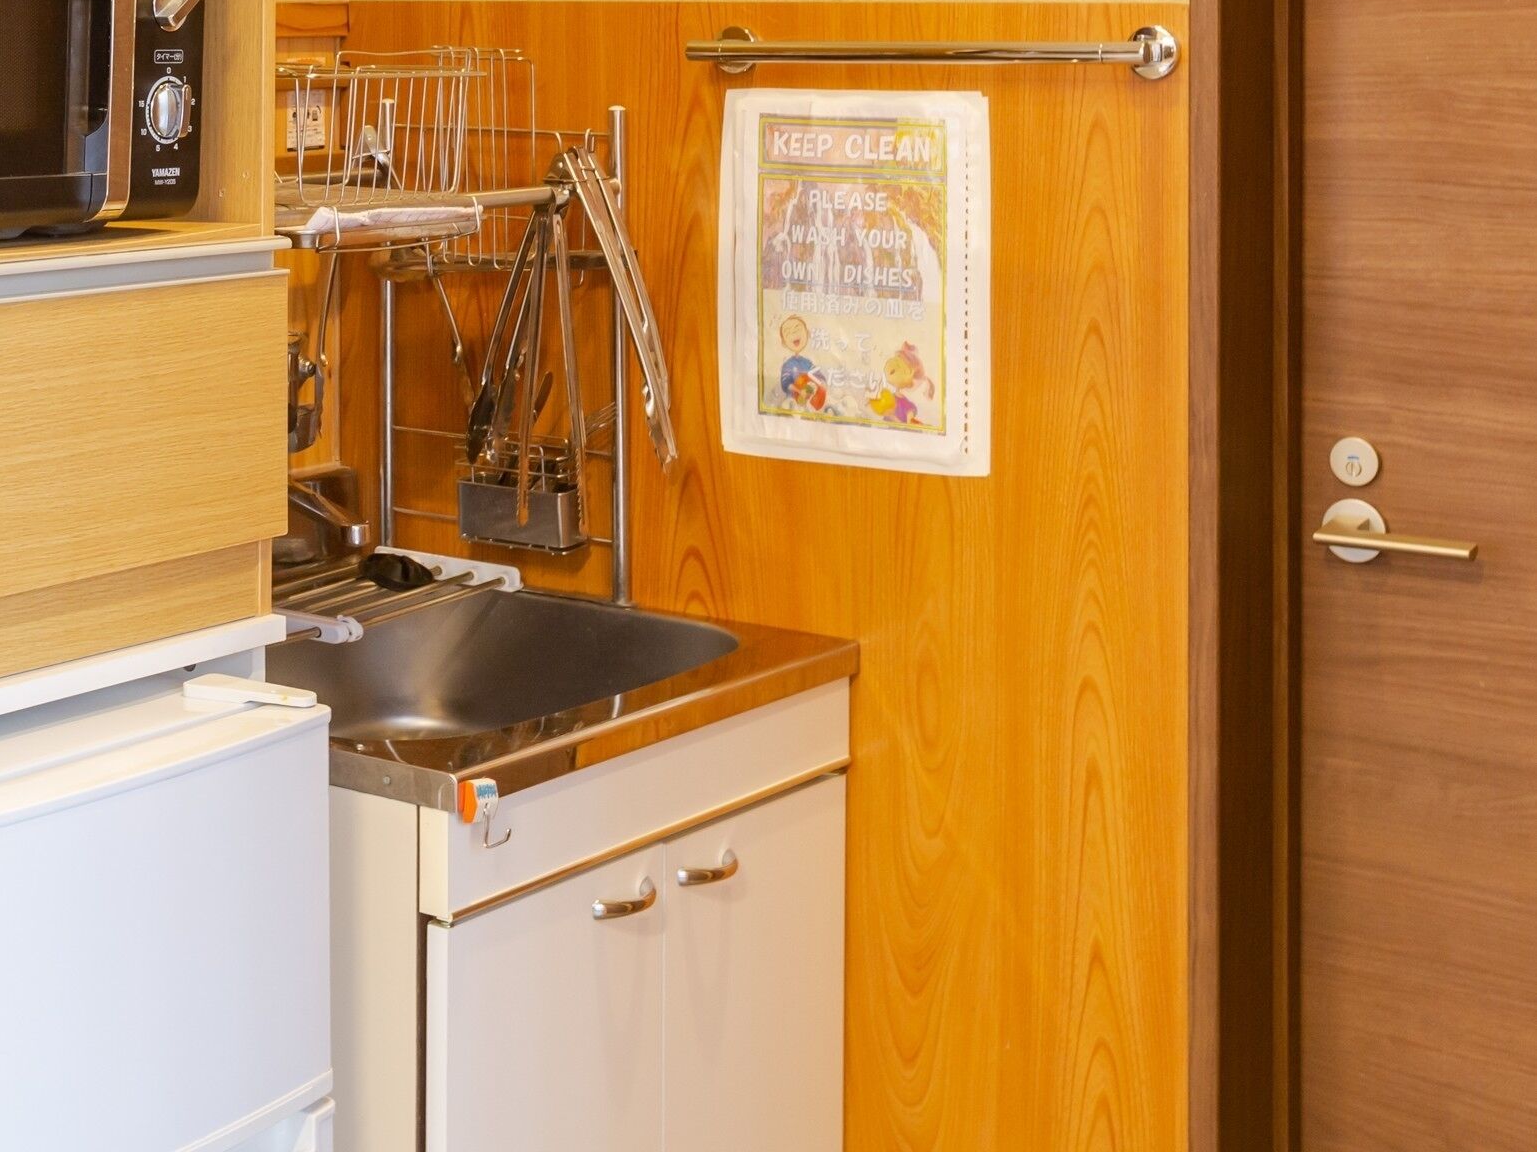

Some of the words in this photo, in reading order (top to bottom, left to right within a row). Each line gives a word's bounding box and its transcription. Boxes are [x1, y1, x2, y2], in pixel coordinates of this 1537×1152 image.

[772, 130, 833, 158] KEEP
[844, 131, 931, 163] CLEAN
[151, 167, 180, 177] YAMAZEN
[807, 189, 889, 213] PLEASE
[791, 225, 846, 248] WASH
[855, 226, 907, 250] YOUR
[781, 260, 820, 282] OWN
